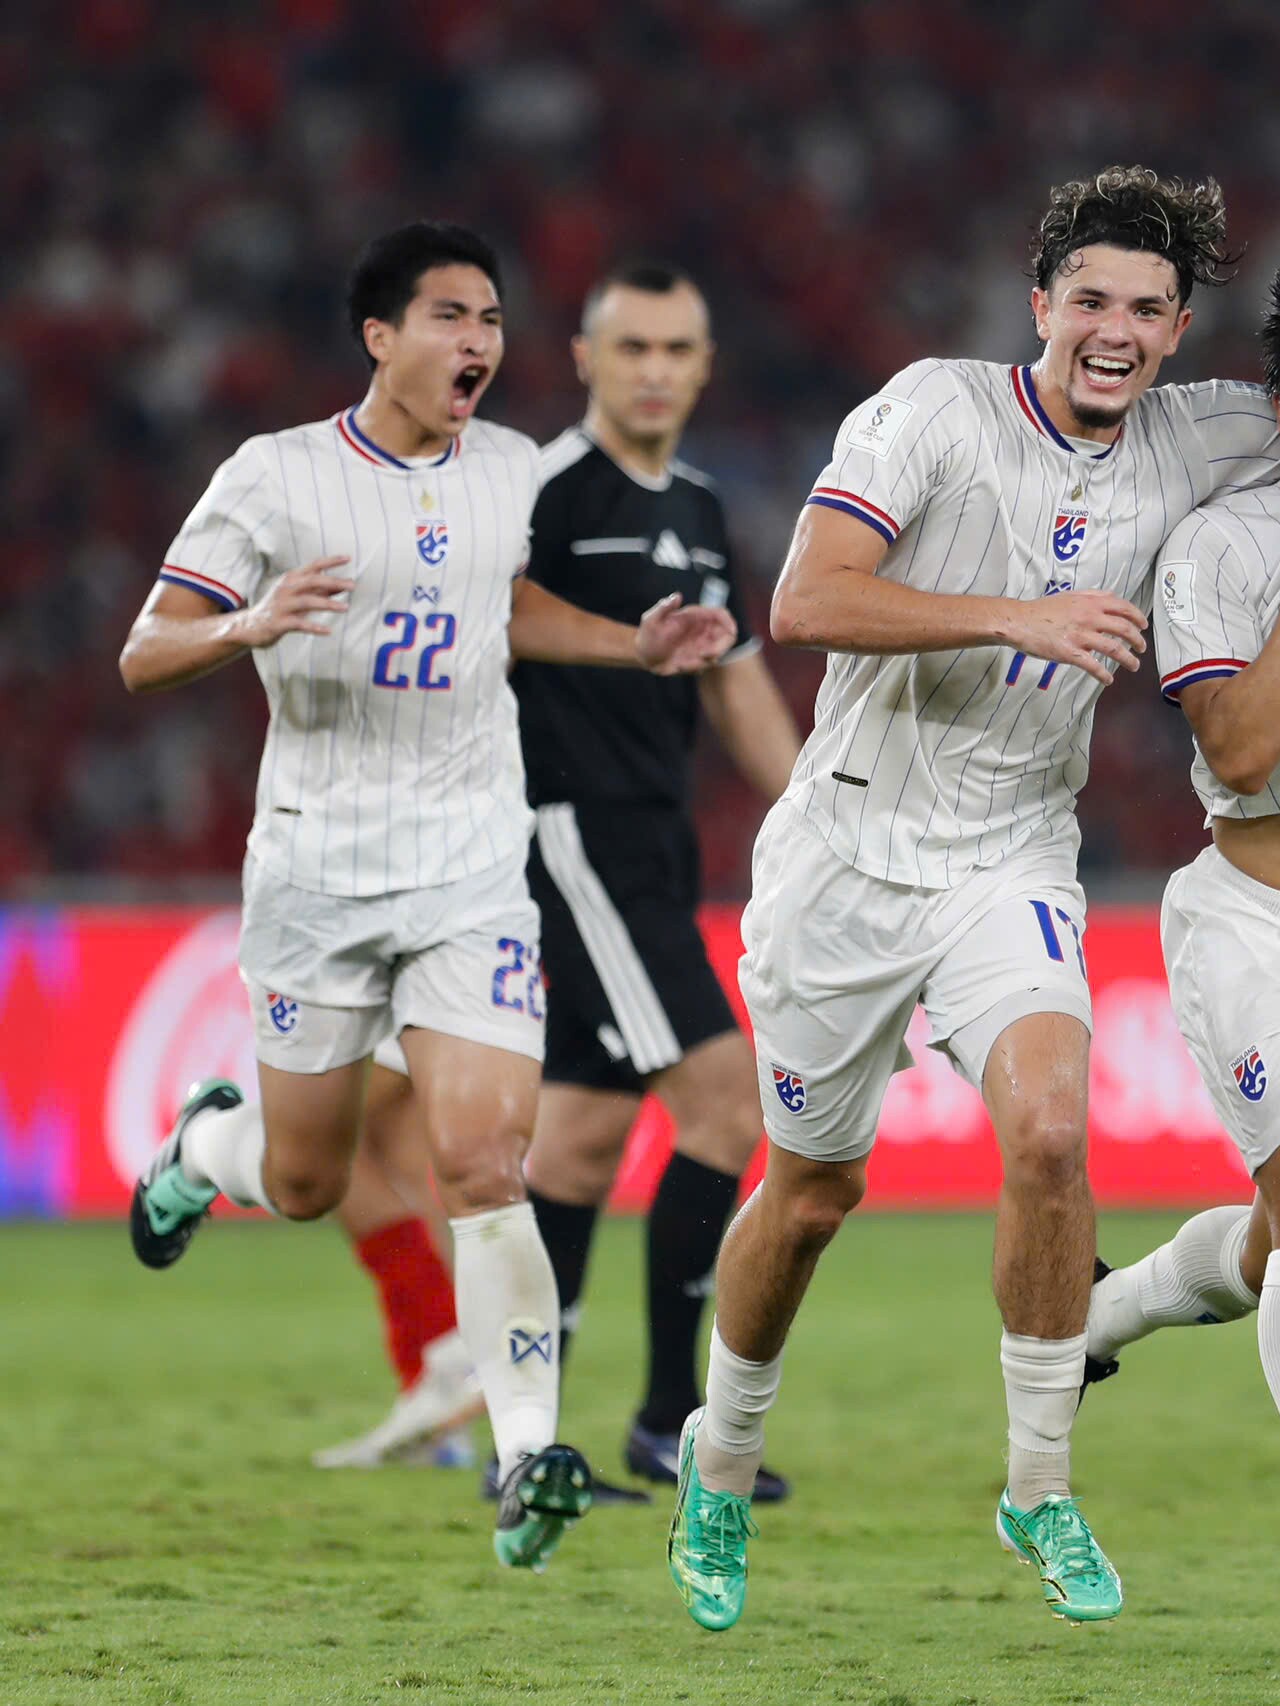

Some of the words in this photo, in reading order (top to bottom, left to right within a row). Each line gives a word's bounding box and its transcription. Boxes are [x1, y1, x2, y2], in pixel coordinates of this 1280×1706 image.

[1058, 508, 1089, 517] THAILAND
[373, 612, 457, 691] 22
[1230, 1044, 1258, 1070] THAILAND
